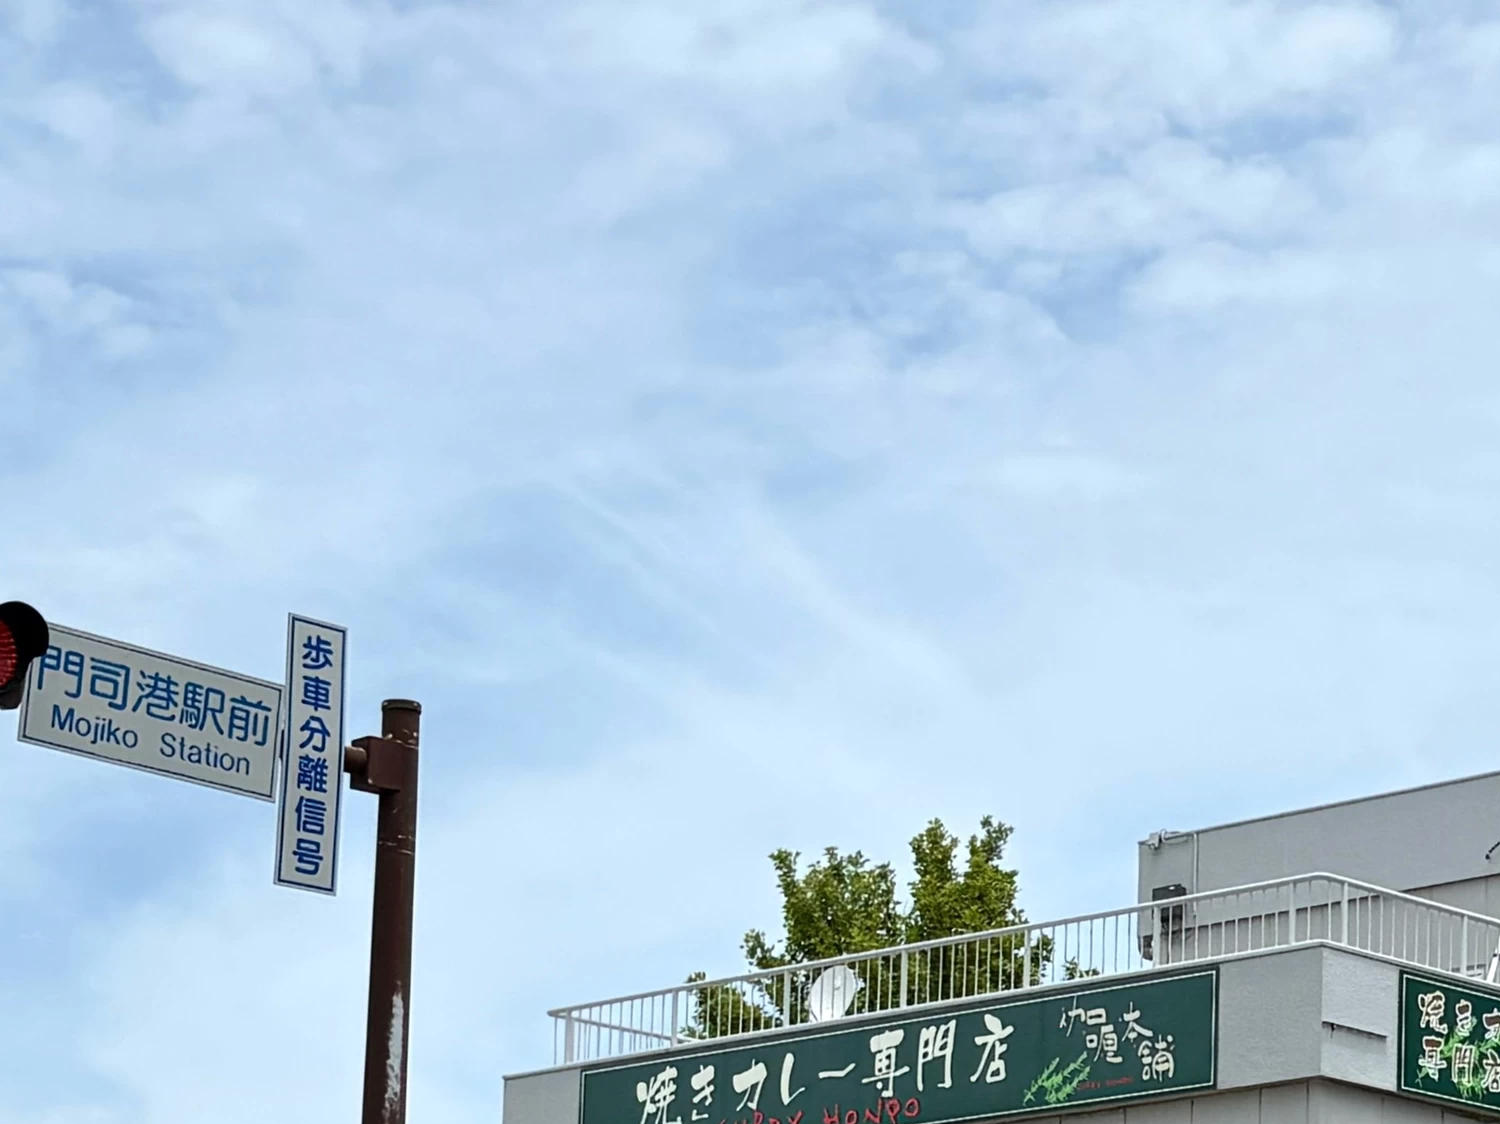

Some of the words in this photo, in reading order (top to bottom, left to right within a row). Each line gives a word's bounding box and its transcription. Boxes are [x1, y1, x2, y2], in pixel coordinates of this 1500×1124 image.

[37, 644, 272, 747] 門司港駅前
[51, 704, 138, 750] Mojiko
[160, 733, 251, 776] Station
[292, 634, 334, 876] 歩車分離信号
